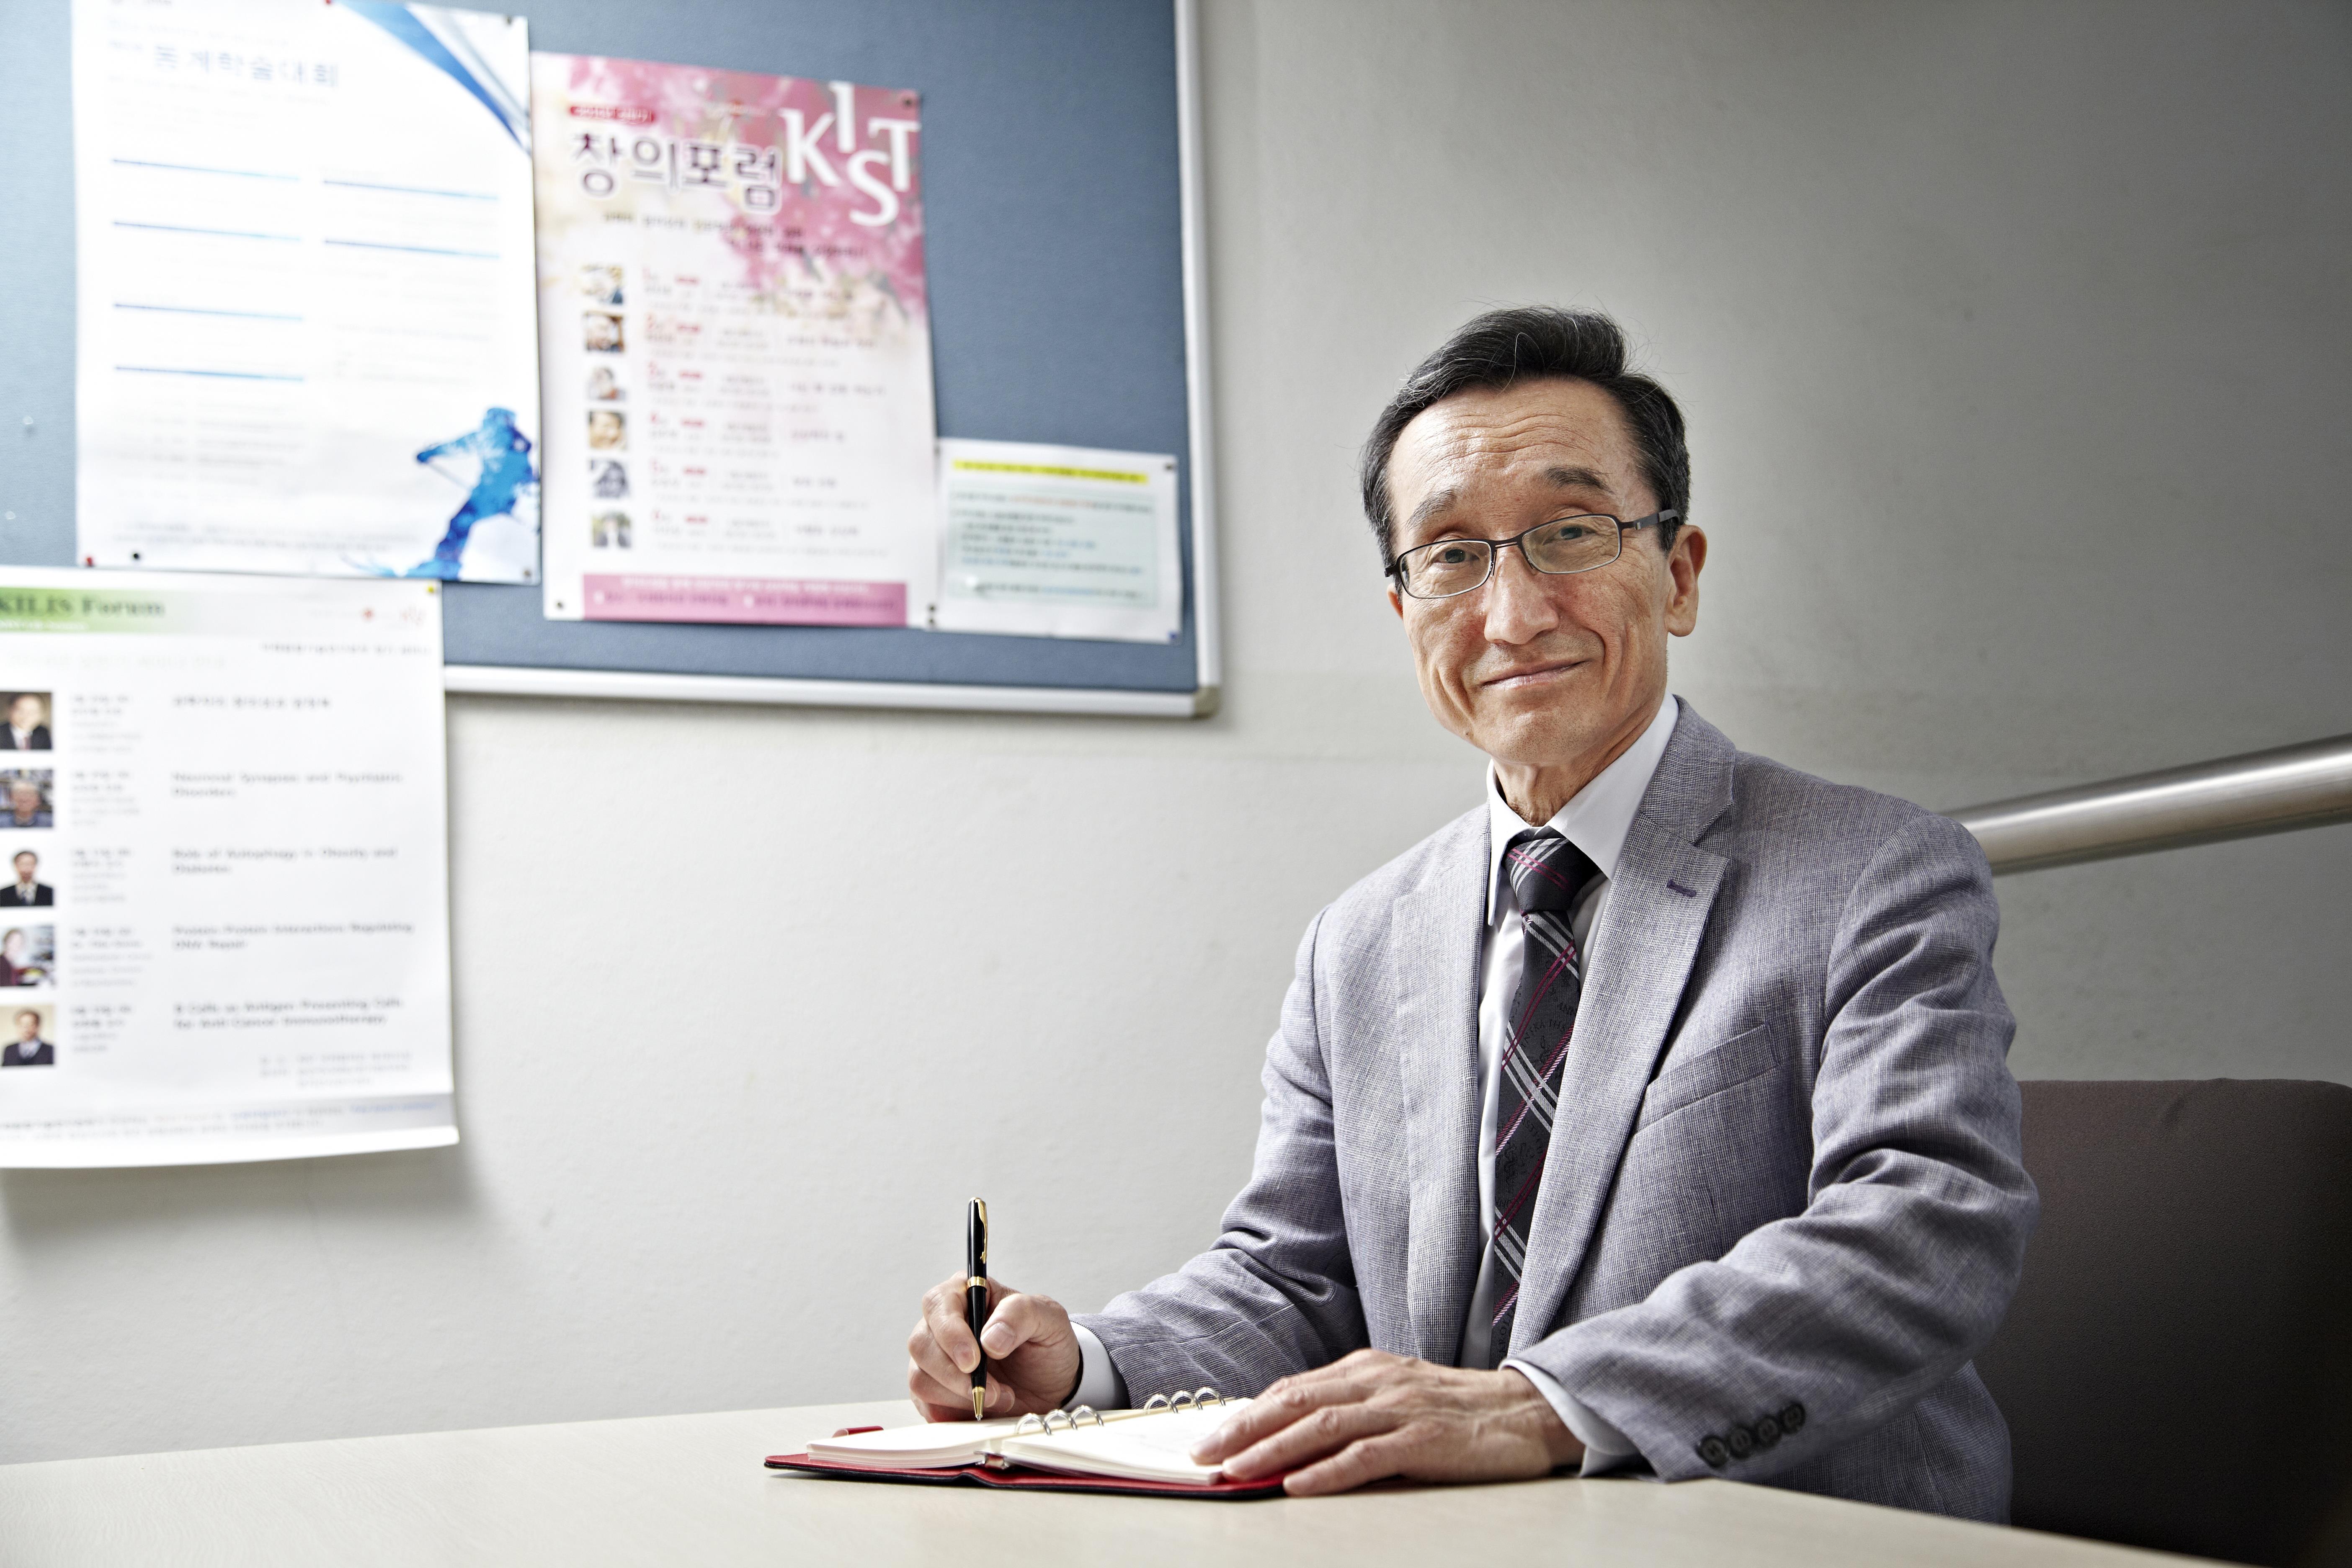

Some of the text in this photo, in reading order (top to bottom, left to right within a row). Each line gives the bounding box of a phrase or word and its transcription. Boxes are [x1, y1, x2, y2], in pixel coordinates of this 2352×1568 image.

[572, 131, 781, 213] 창의포럼
[81, 595, 166, 618] Forum
[306, 771, 330, 783] and
[172, 787, 236, 798] Disorders
[172, 847, 201, 859] Role
[206, 847, 221, 859] of
[226, 848, 297, 861] Autophagy
[320, 847, 368, 861] Obesity
[372, 847, 397, 858] and
[172, 864, 231, 874] Diabetes
[172, 939, 248, 952] DNA Repair
[244, 1001, 295, 1015] Antigen
[300, 999, 370, 1013] Presenting
[174, 1018, 194, 1030] for
[282, 1014, 387, 1028] Immunotherapy
